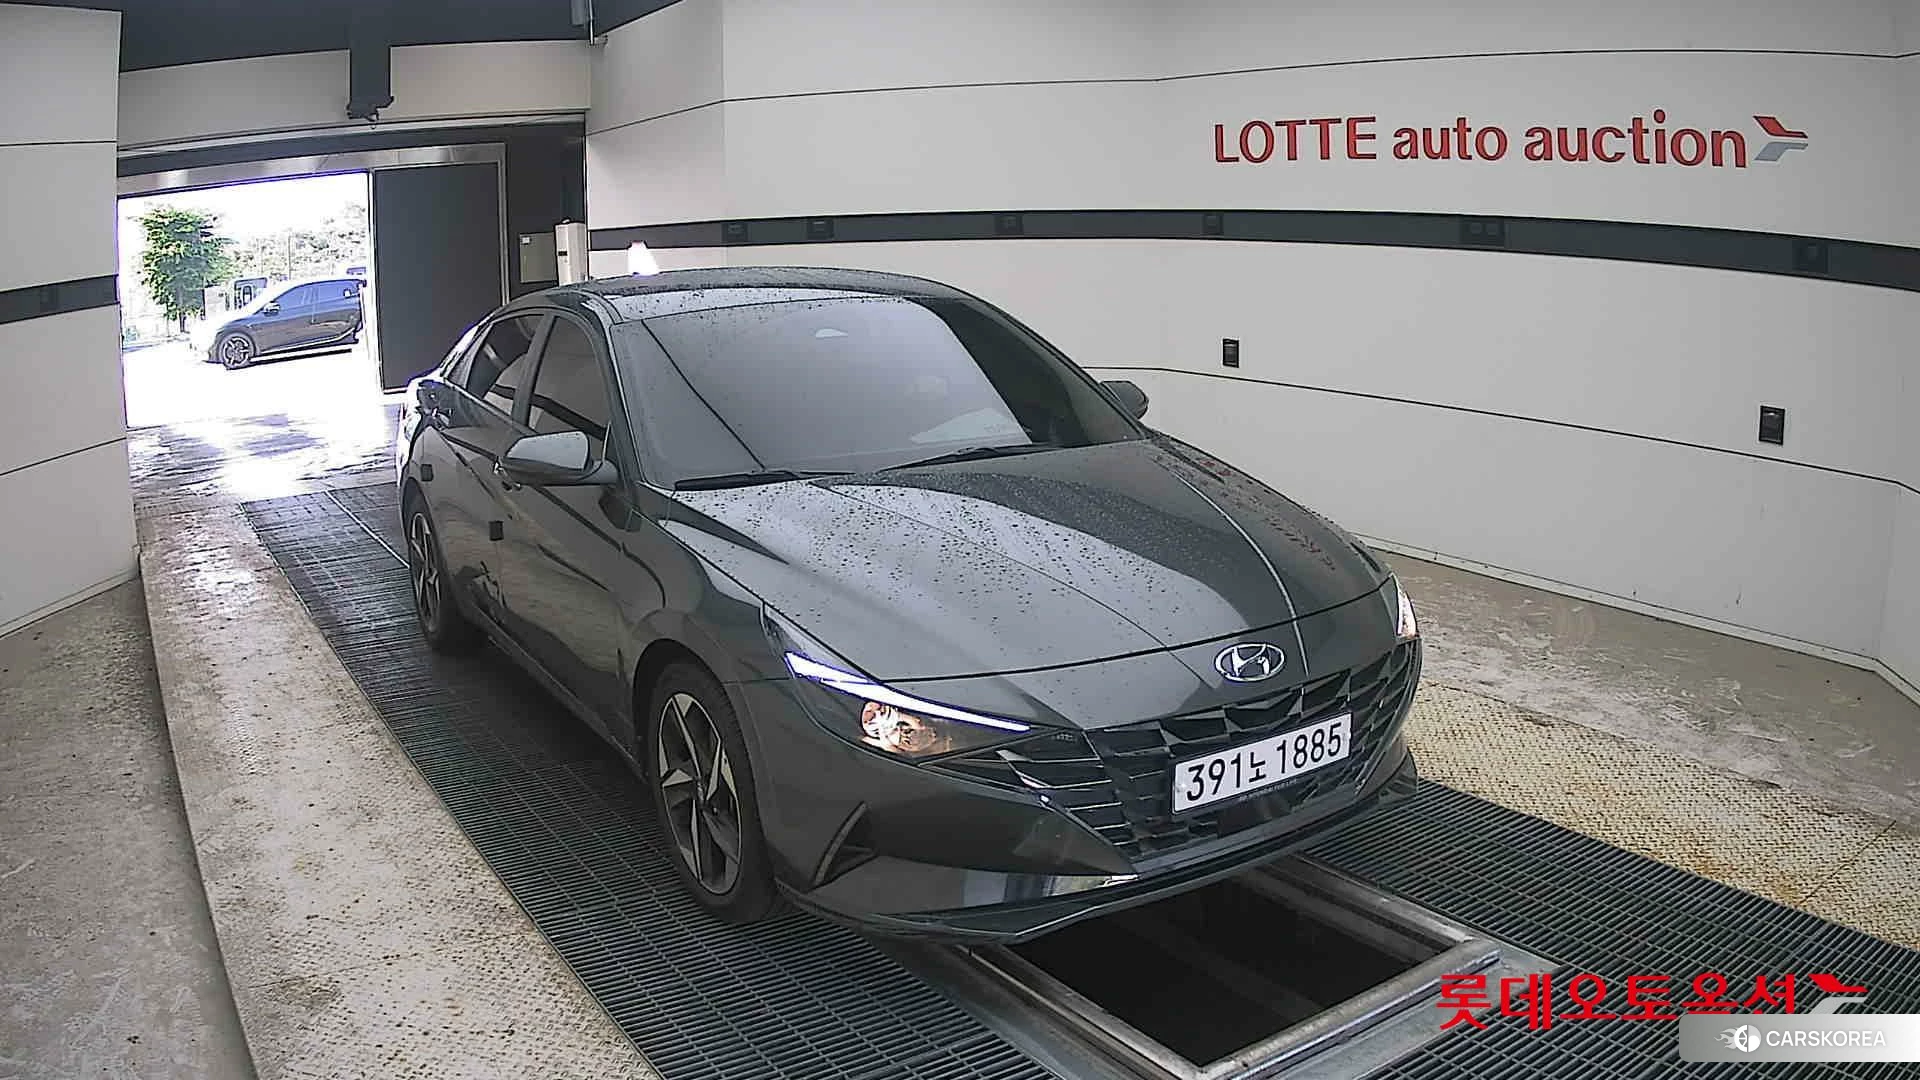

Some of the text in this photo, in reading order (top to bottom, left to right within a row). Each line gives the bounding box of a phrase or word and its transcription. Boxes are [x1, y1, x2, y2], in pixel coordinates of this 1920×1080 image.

[1214, 109, 1748, 168] LOTTE auto auction
[1186, 751, 1267, 802] 391노
[1275, 721, 1343, 775] 1885
